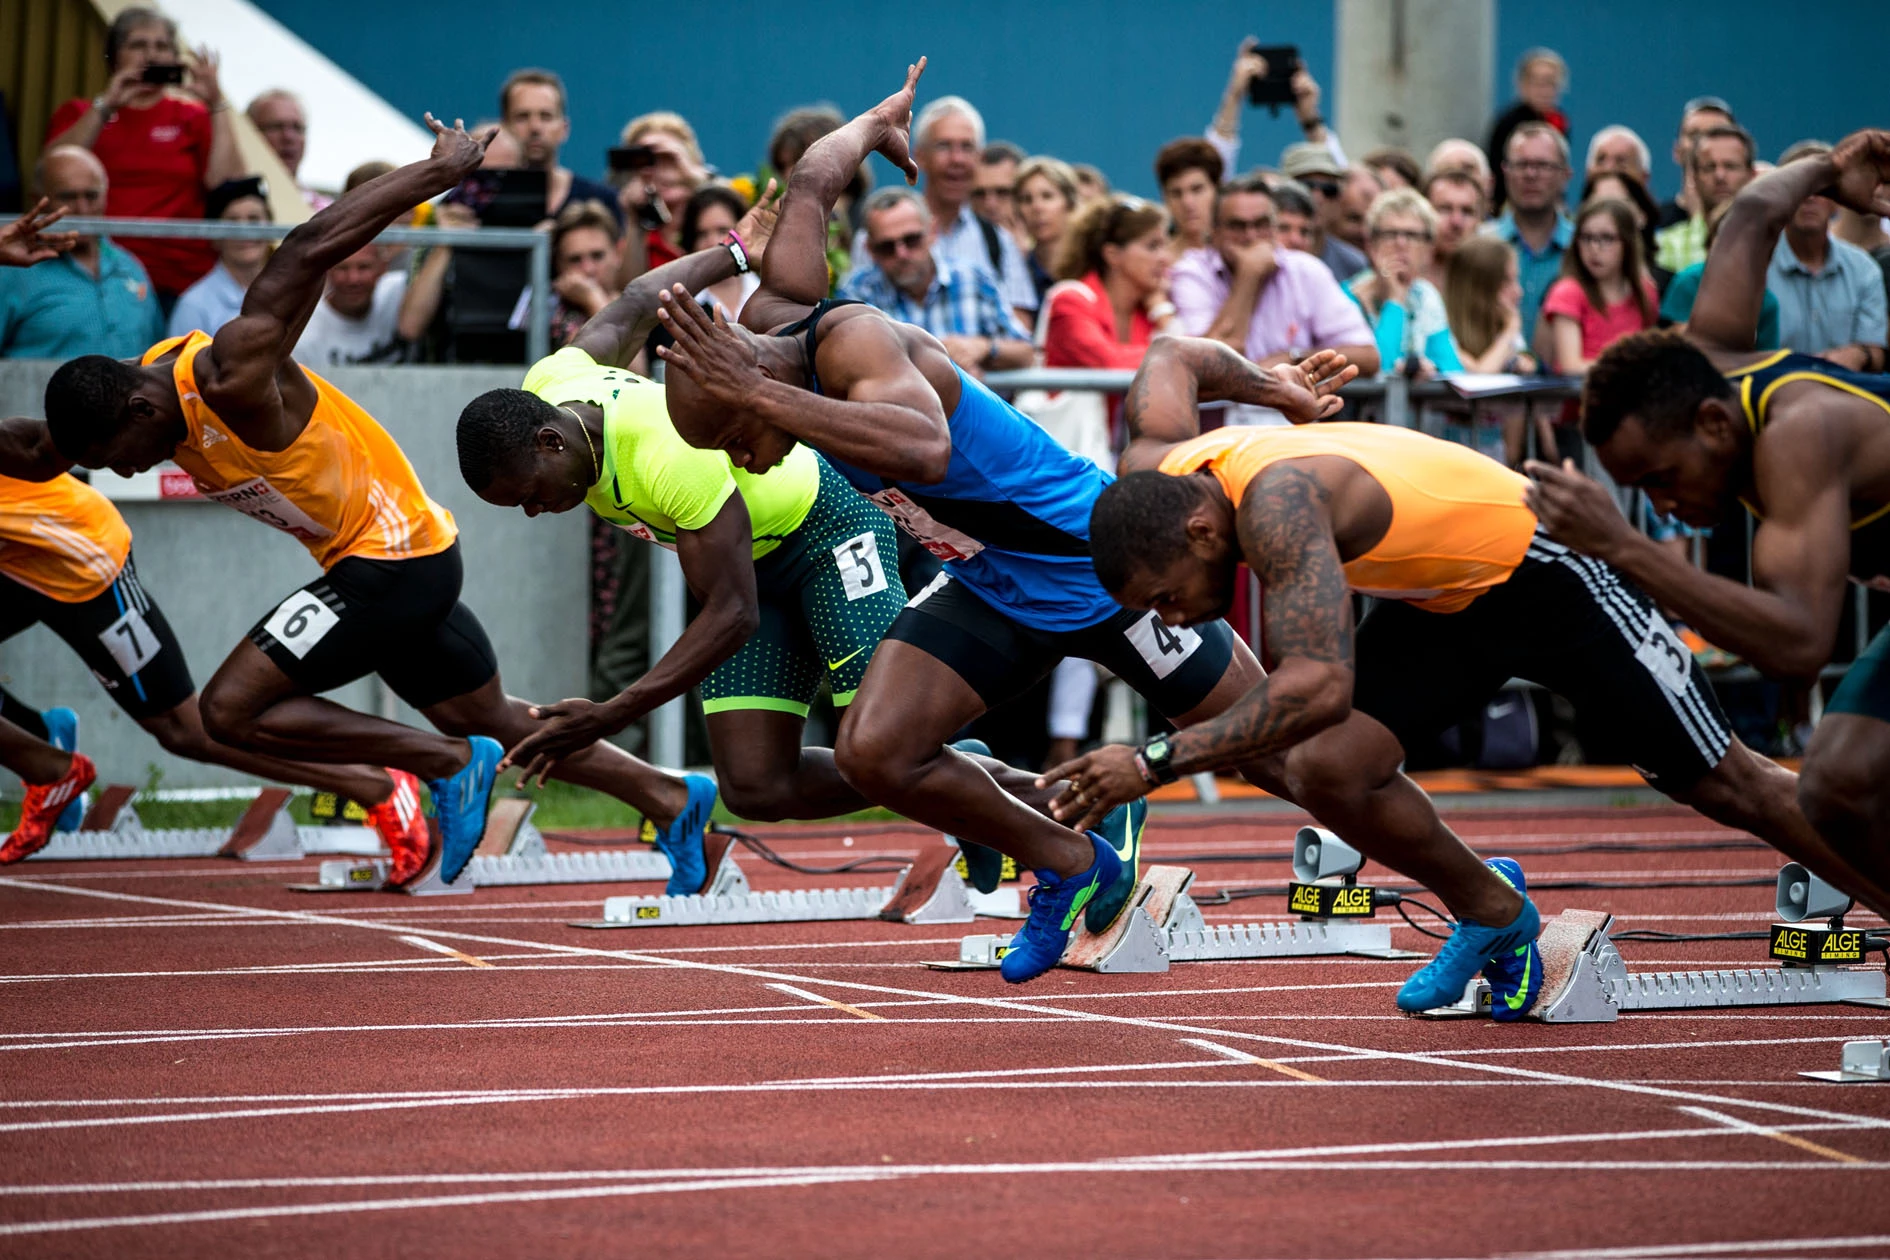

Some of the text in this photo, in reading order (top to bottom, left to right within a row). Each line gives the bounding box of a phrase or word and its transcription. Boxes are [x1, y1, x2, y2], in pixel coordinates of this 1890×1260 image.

[849, 541, 874, 588] 5
[283, 603, 320, 638] 6
[115, 621, 143, 660] 7
[1150, 614, 1184, 656] 4
[1650, 632, 1686, 674] 3
[1292, 886, 1320, 906] ALGE
[1333, 888, 1370, 906] ALGE
[1775, 930, 1807, 950] ALGE
[1775, 948, 1805, 958] TIMING
[1822, 933, 1860, 951] ALGE
